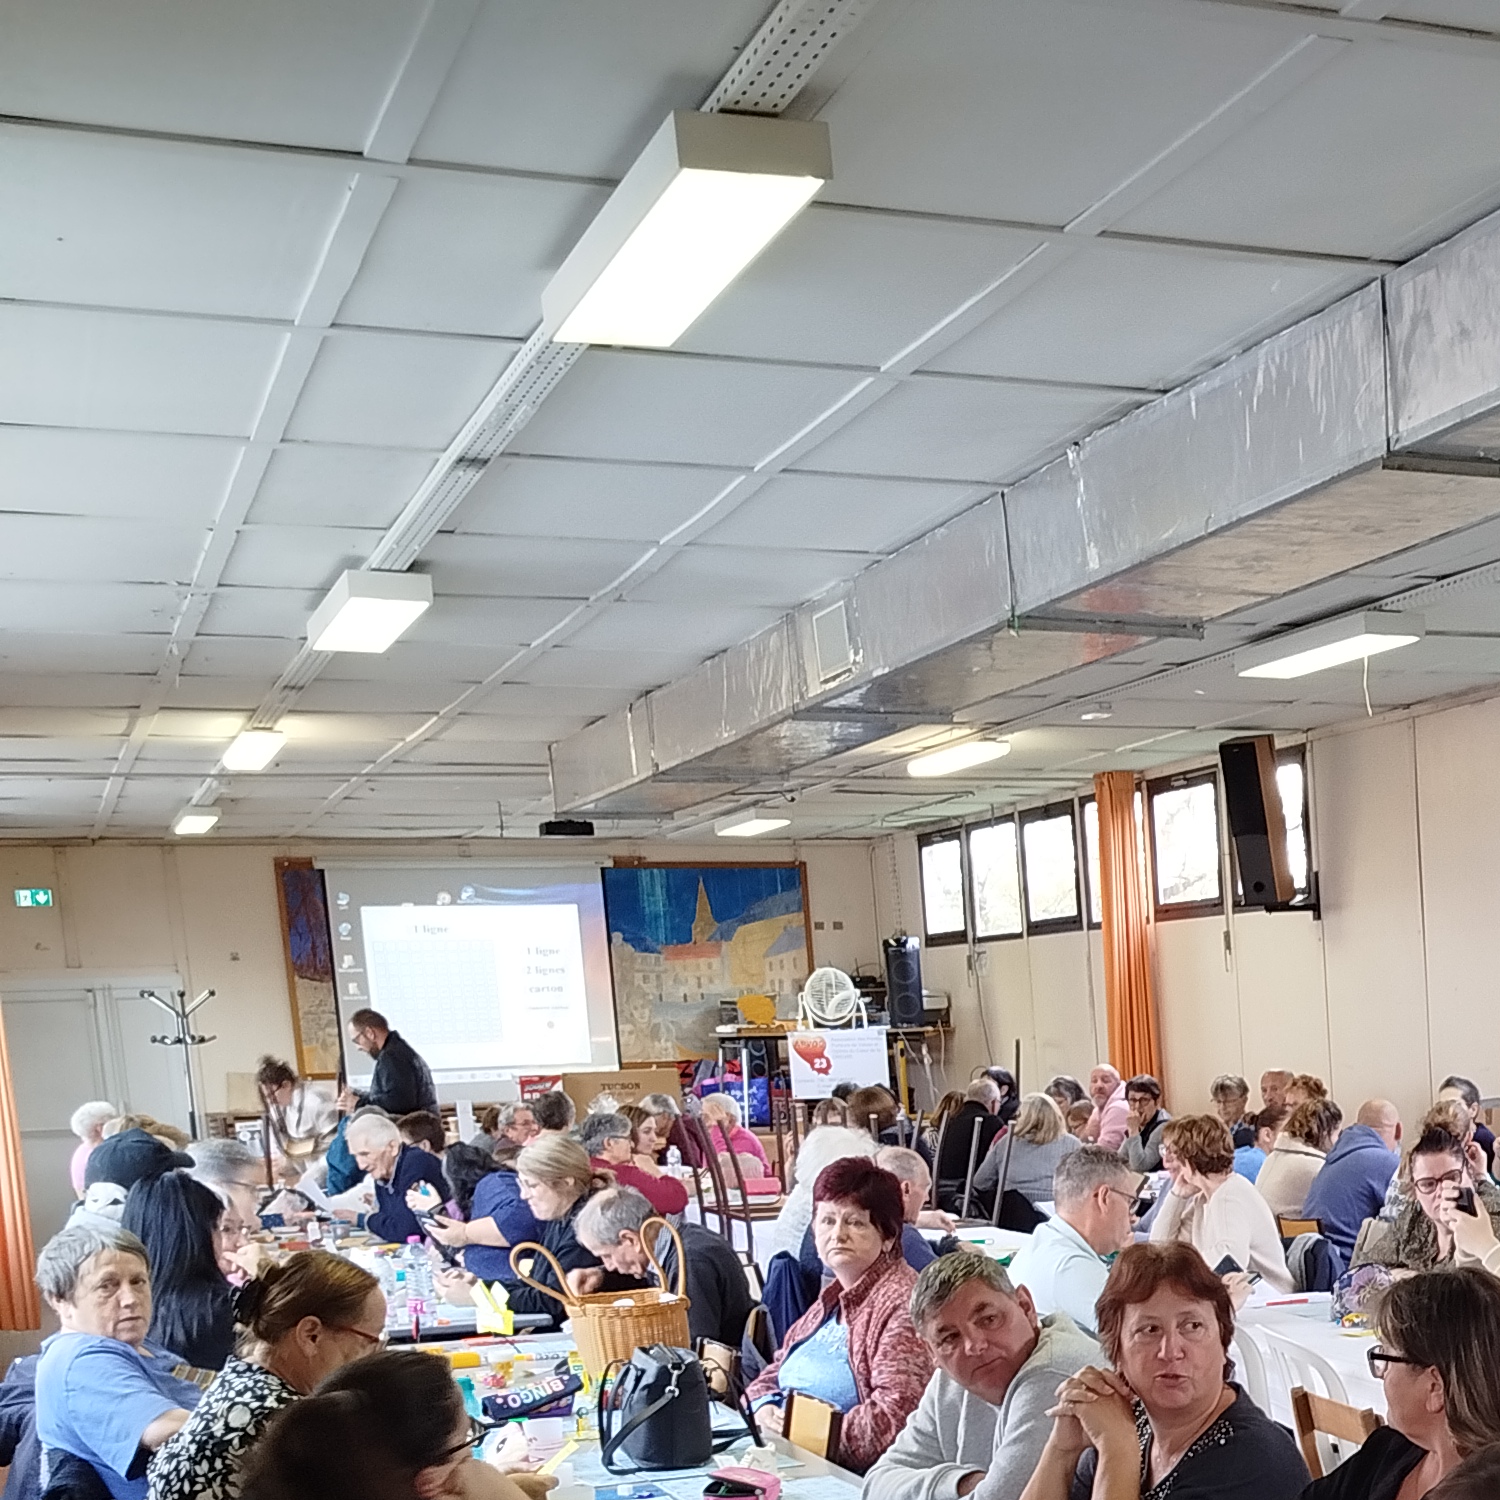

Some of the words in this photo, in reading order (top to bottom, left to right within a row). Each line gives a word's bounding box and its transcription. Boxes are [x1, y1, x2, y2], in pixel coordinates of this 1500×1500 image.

[422, 923, 450, 936] ligne
[535, 946, 561, 958] ligne
[535, 965, 566, 976] lignes
[528, 985, 564, 994] carton
[813, 1058, 828, 1069] 23
[600, 1082, 641, 1091] TUCSON
[507, 1378, 565, 1408] BINGO
